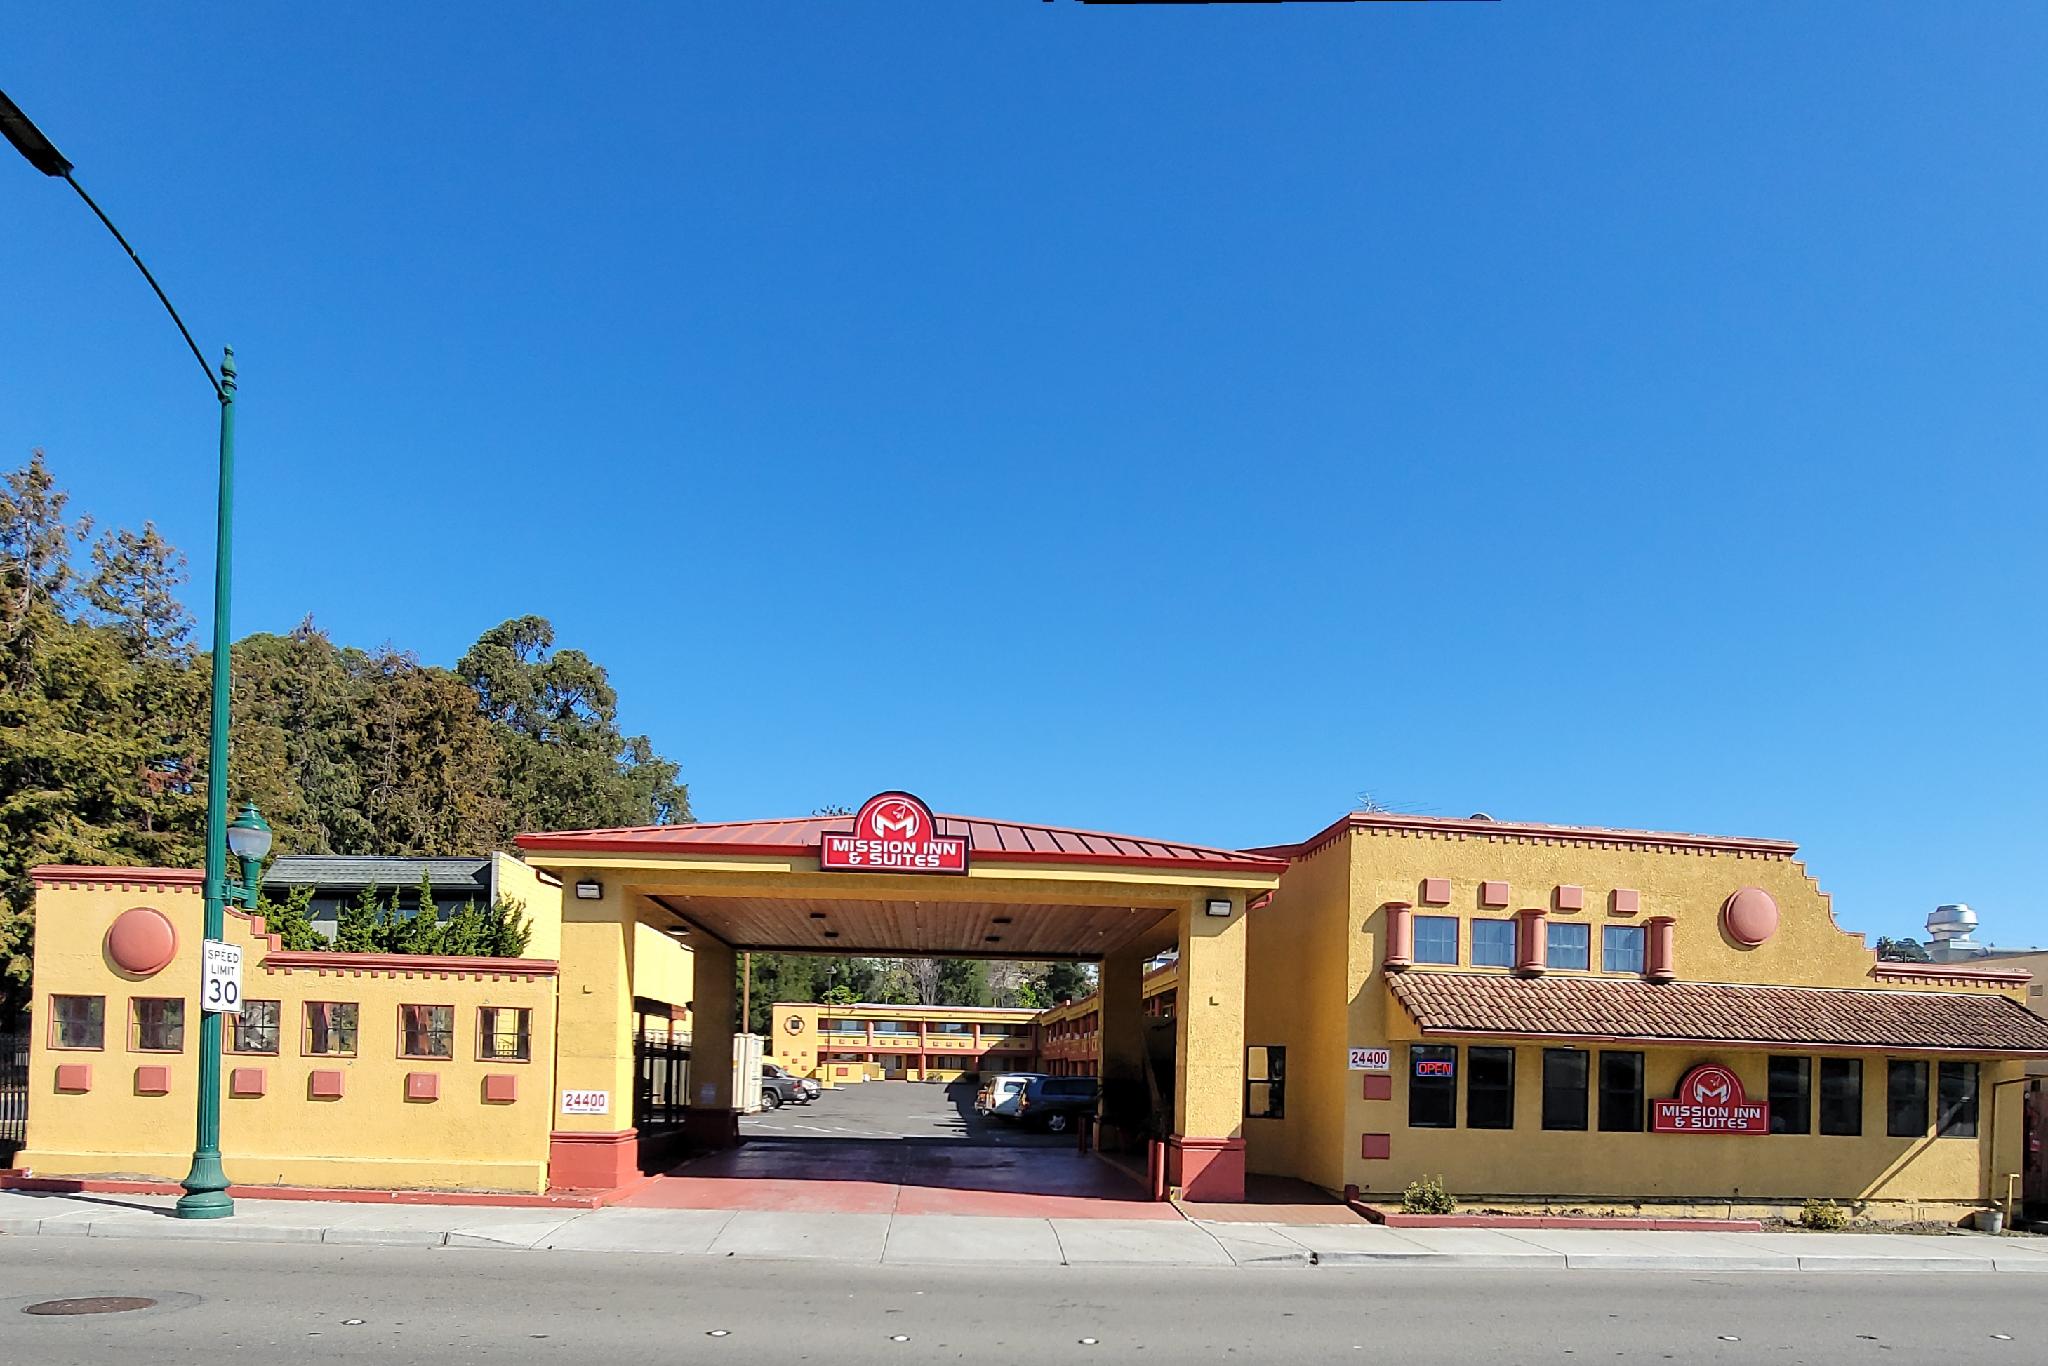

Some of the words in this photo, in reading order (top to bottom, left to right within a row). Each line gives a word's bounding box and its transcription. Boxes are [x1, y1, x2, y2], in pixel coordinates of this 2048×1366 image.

[833, 840, 916, 854] MISSION
[922, 842, 957, 856] INN
[848, 851, 863, 865] &
[869, 853, 940, 866] SUITES
[207, 949, 239, 964] SPEED
[211, 963, 235, 976] LIMIT
[208, 978, 238, 1005] 30
[1351, 1051, 1388, 1065] 24400
[1418, 1063, 1451, 1074] OPEN
[565, 1093, 605, 1107] 24400
[1662, 1105, 1729, 1117] MISSION
[1734, 1107, 1761, 1119] INN
[1674, 1117, 1686, 1128] &
[1691, 1117, 1748, 1129] SUITES
